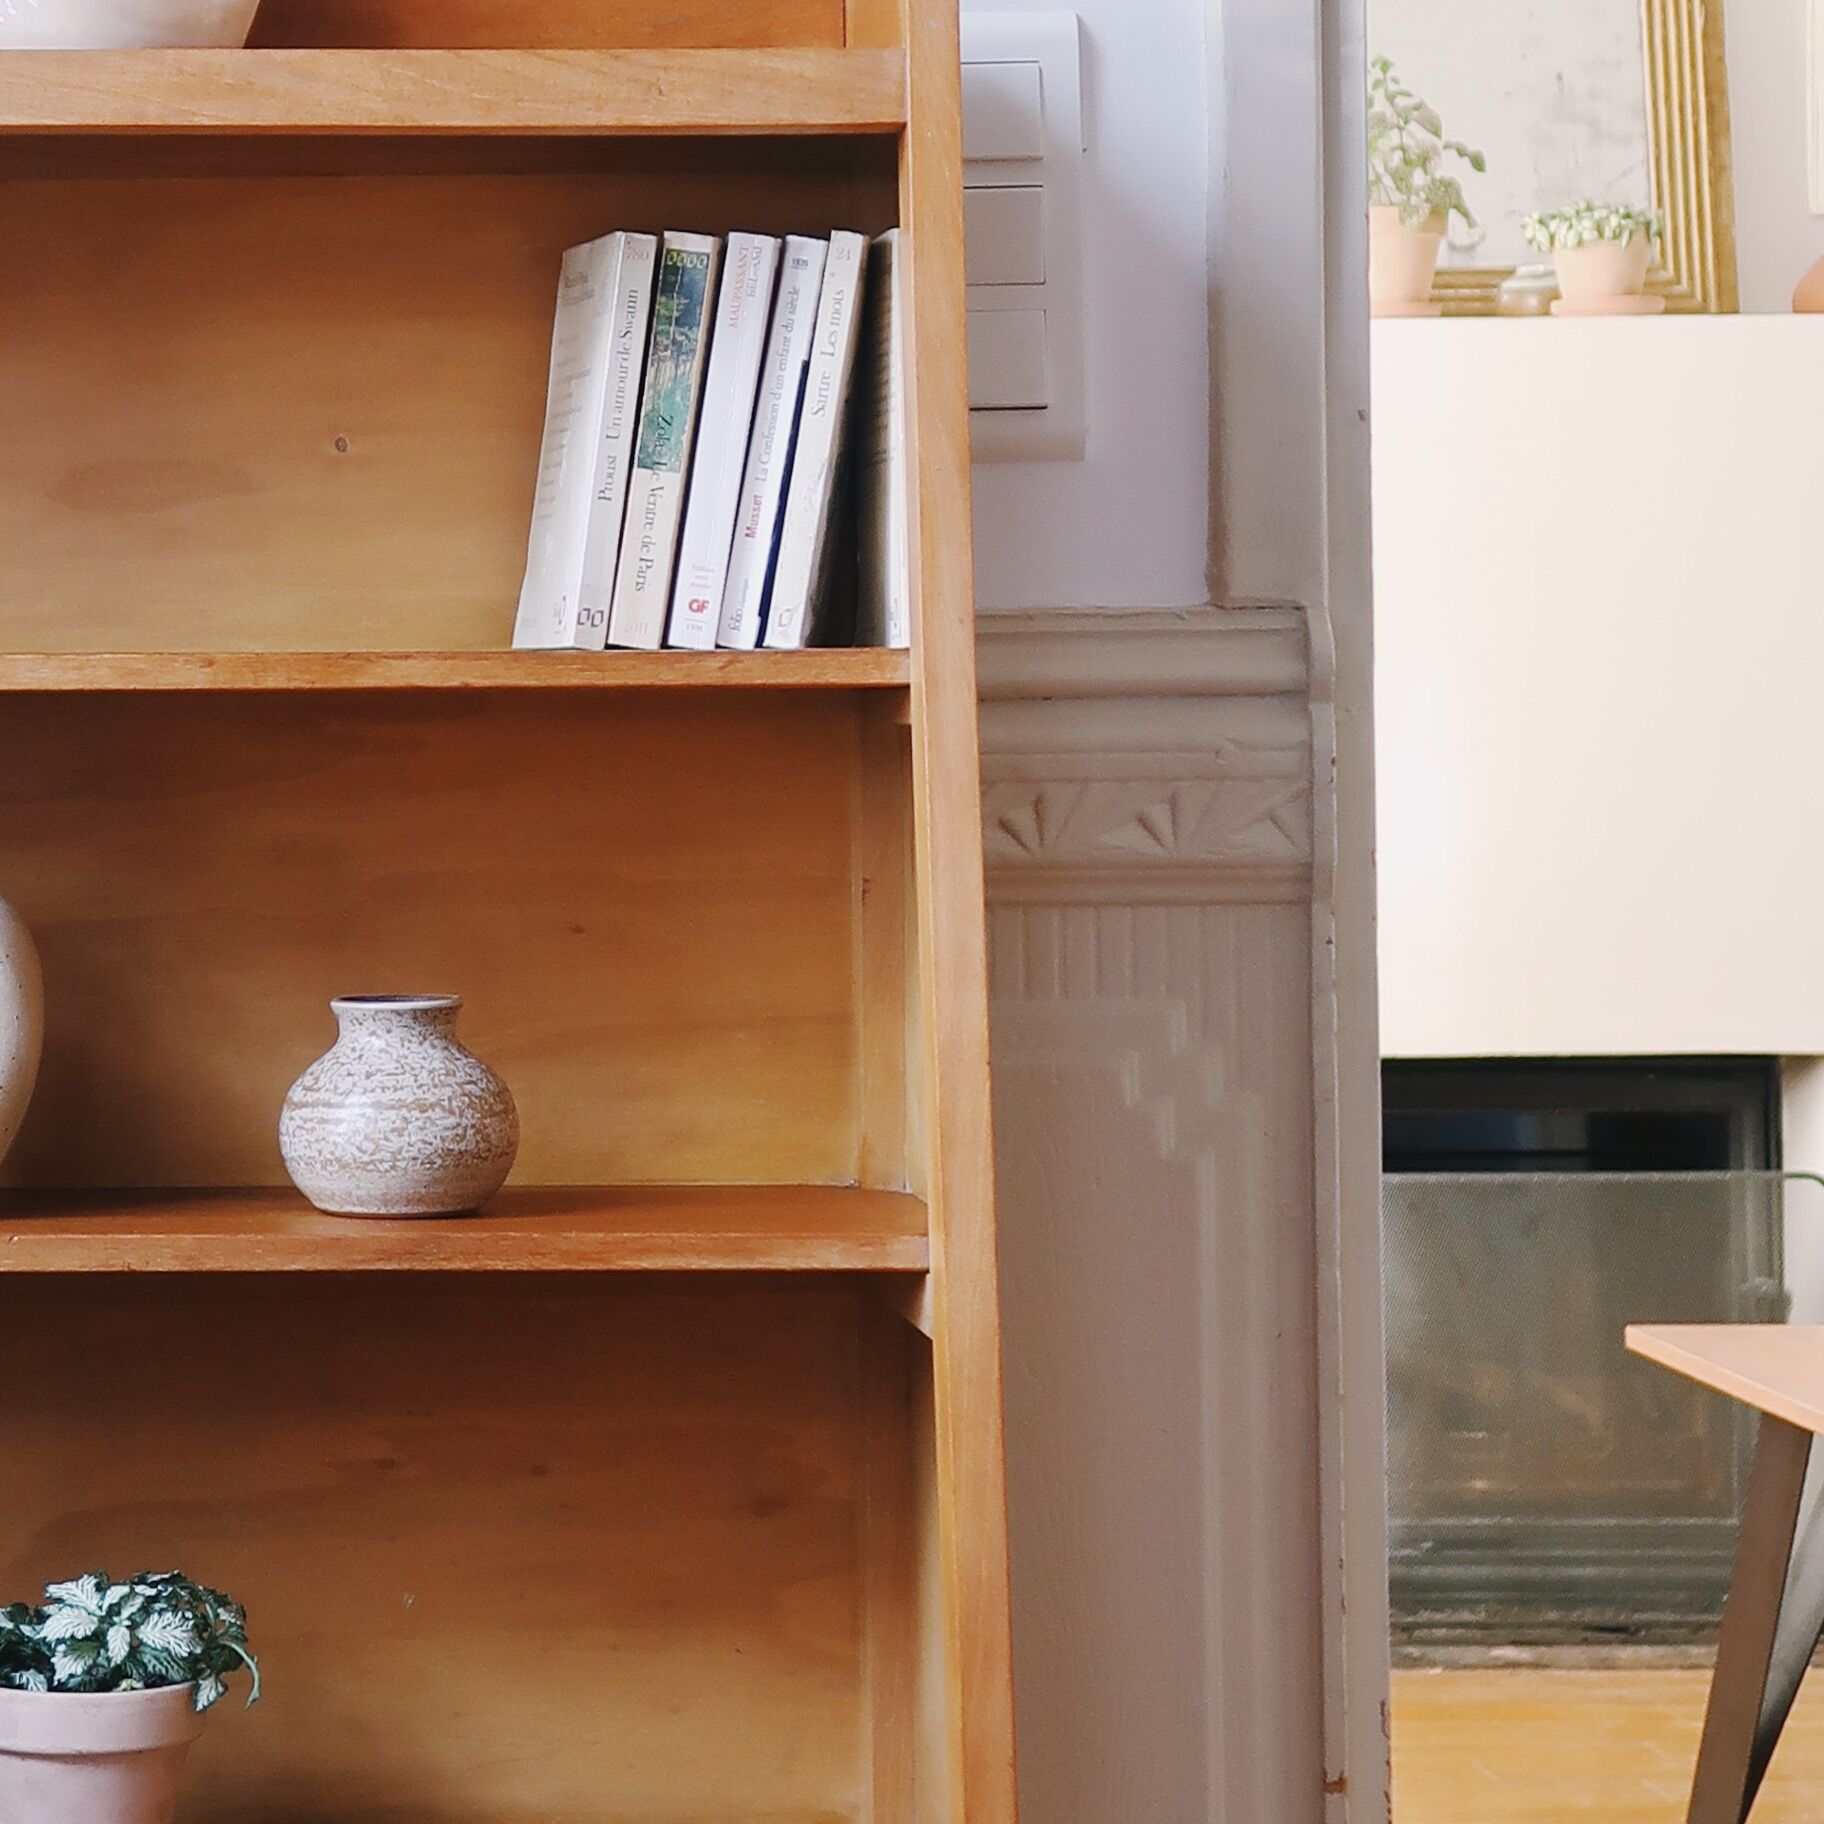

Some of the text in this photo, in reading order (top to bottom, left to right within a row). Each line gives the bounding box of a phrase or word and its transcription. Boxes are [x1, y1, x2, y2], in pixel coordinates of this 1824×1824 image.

[728, 246, 749, 329] MAUPASSANT
[781, 317, 794, 333] du
[820, 289, 845, 357] Les mots
[605, 289, 639, 441] Un amour de Swann
[776, 337, 792, 371] enfant
[811, 371, 831, 417] Sartre
[655, 415, 674, 448] Zola
[758, 403, 780, 463] Confession
[598, 455, 618, 501] Proust
[755, 467, 768, 482] La
[635, 459, 667, 592] Le Ventre de Paris
[745, 494, 764, 539] Musset
[688, 598, 710, 613] GF
